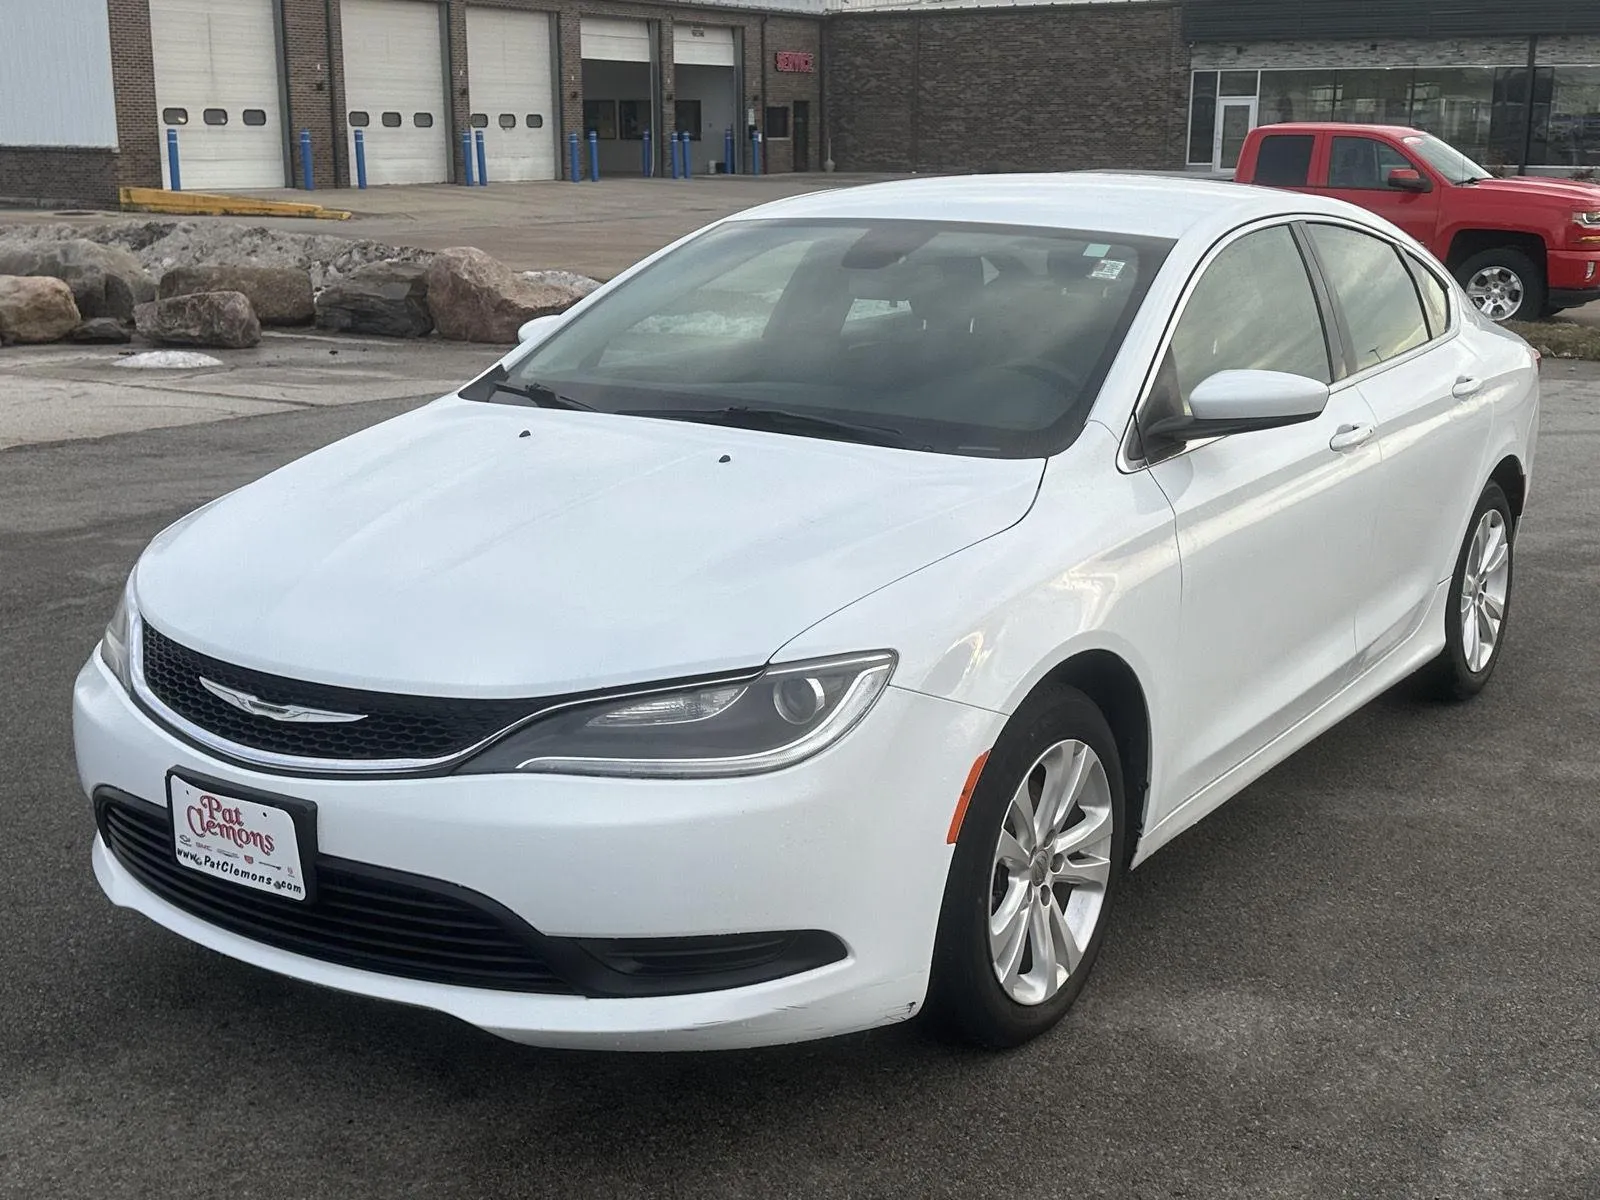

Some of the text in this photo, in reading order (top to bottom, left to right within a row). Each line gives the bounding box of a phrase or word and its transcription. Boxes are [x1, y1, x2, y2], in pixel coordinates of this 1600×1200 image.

[776, 51, 814, 72] SERVICE
[200, 796, 244, 826] Pat
[187, 805, 275, 856] Clemons
